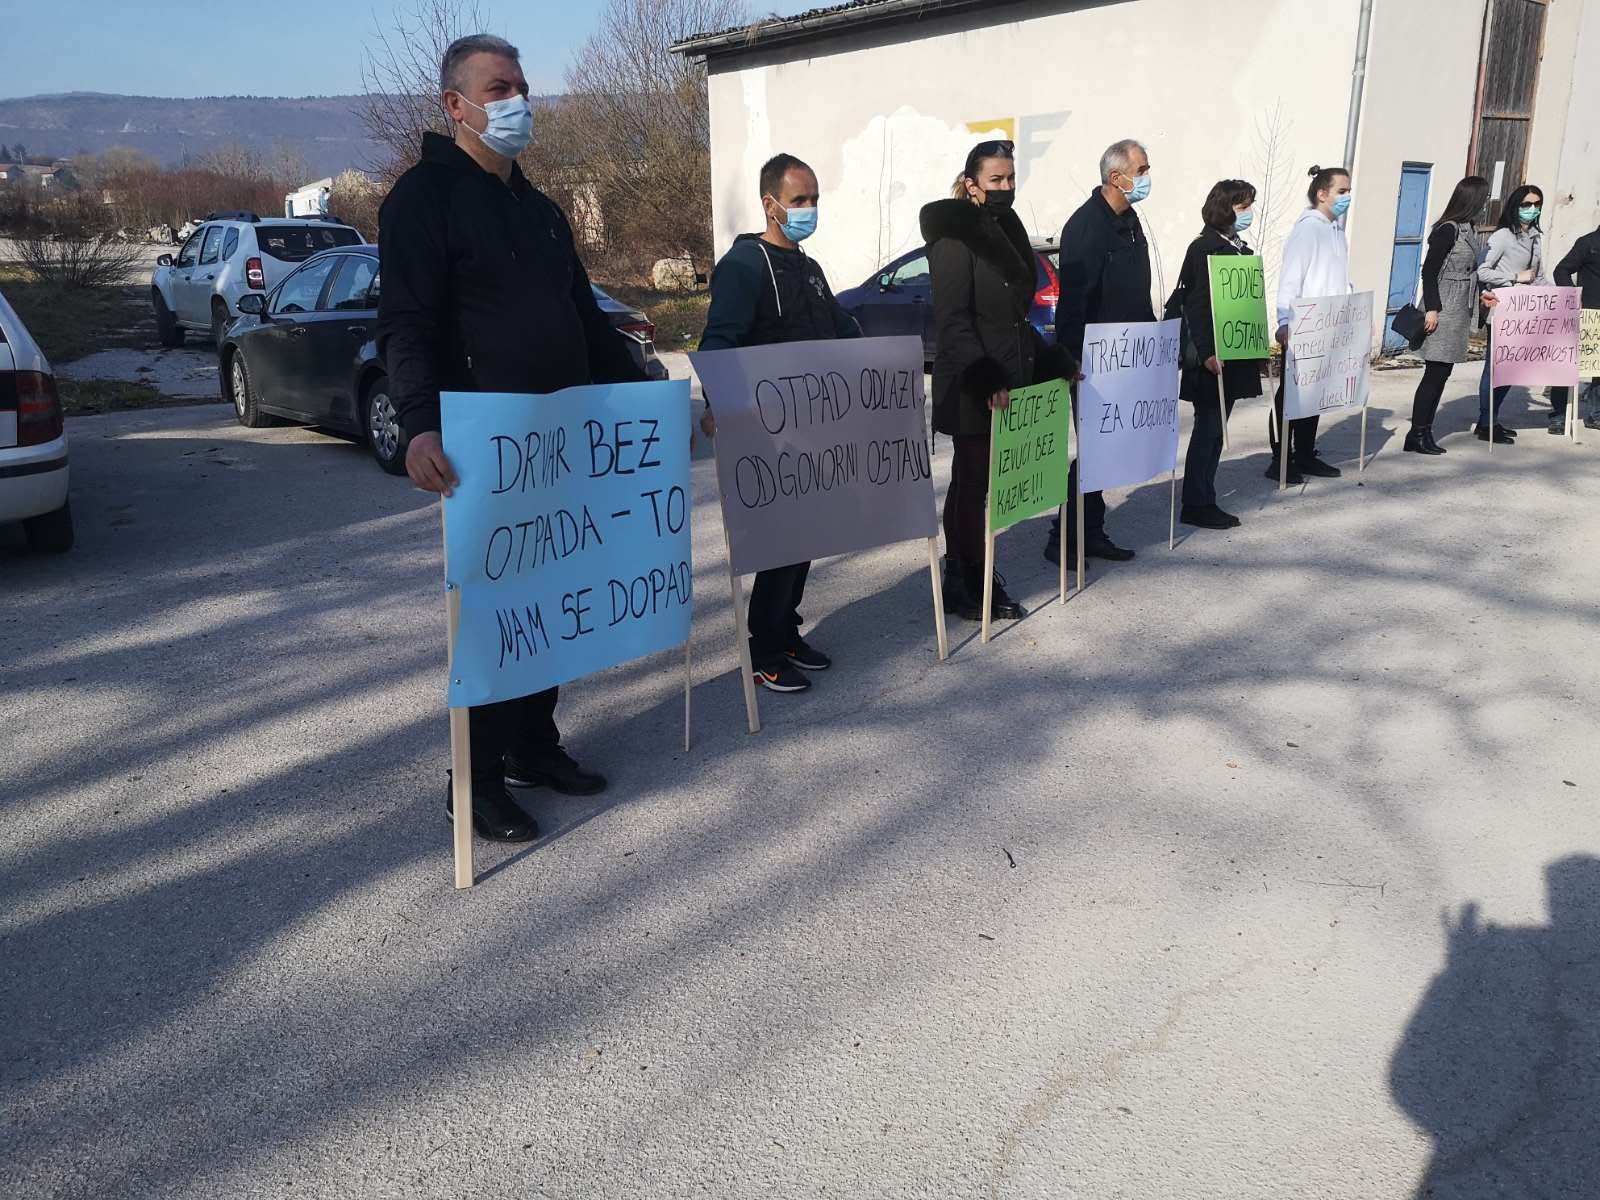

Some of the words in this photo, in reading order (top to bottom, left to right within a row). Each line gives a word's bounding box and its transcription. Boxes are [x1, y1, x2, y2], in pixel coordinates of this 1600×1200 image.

[1506, 294, 1558, 312] MINISTRE
[1088, 328, 1155, 374] TRAŽIMO
[756, 371, 850, 434] OTPAD
[1045, 388, 1060, 418] SE
[1100, 403, 1124, 434] ZA
[490, 427, 571, 494] DRVAR
[584, 420, 661, 478] BEZ
[735, 444, 858, 509] ODGOVORNI
[867, 438, 931, 486] OSTAJU
[998, 431, 1032, 478] IZVUĆI
[1035, 432, 1055, 462] BEZ
[486, 505, 602, 581] OTPADA
[641, 486, 685, 537] TO
[496, 602, 550, 669] NAM
[561, 588, 594, 640] SE
